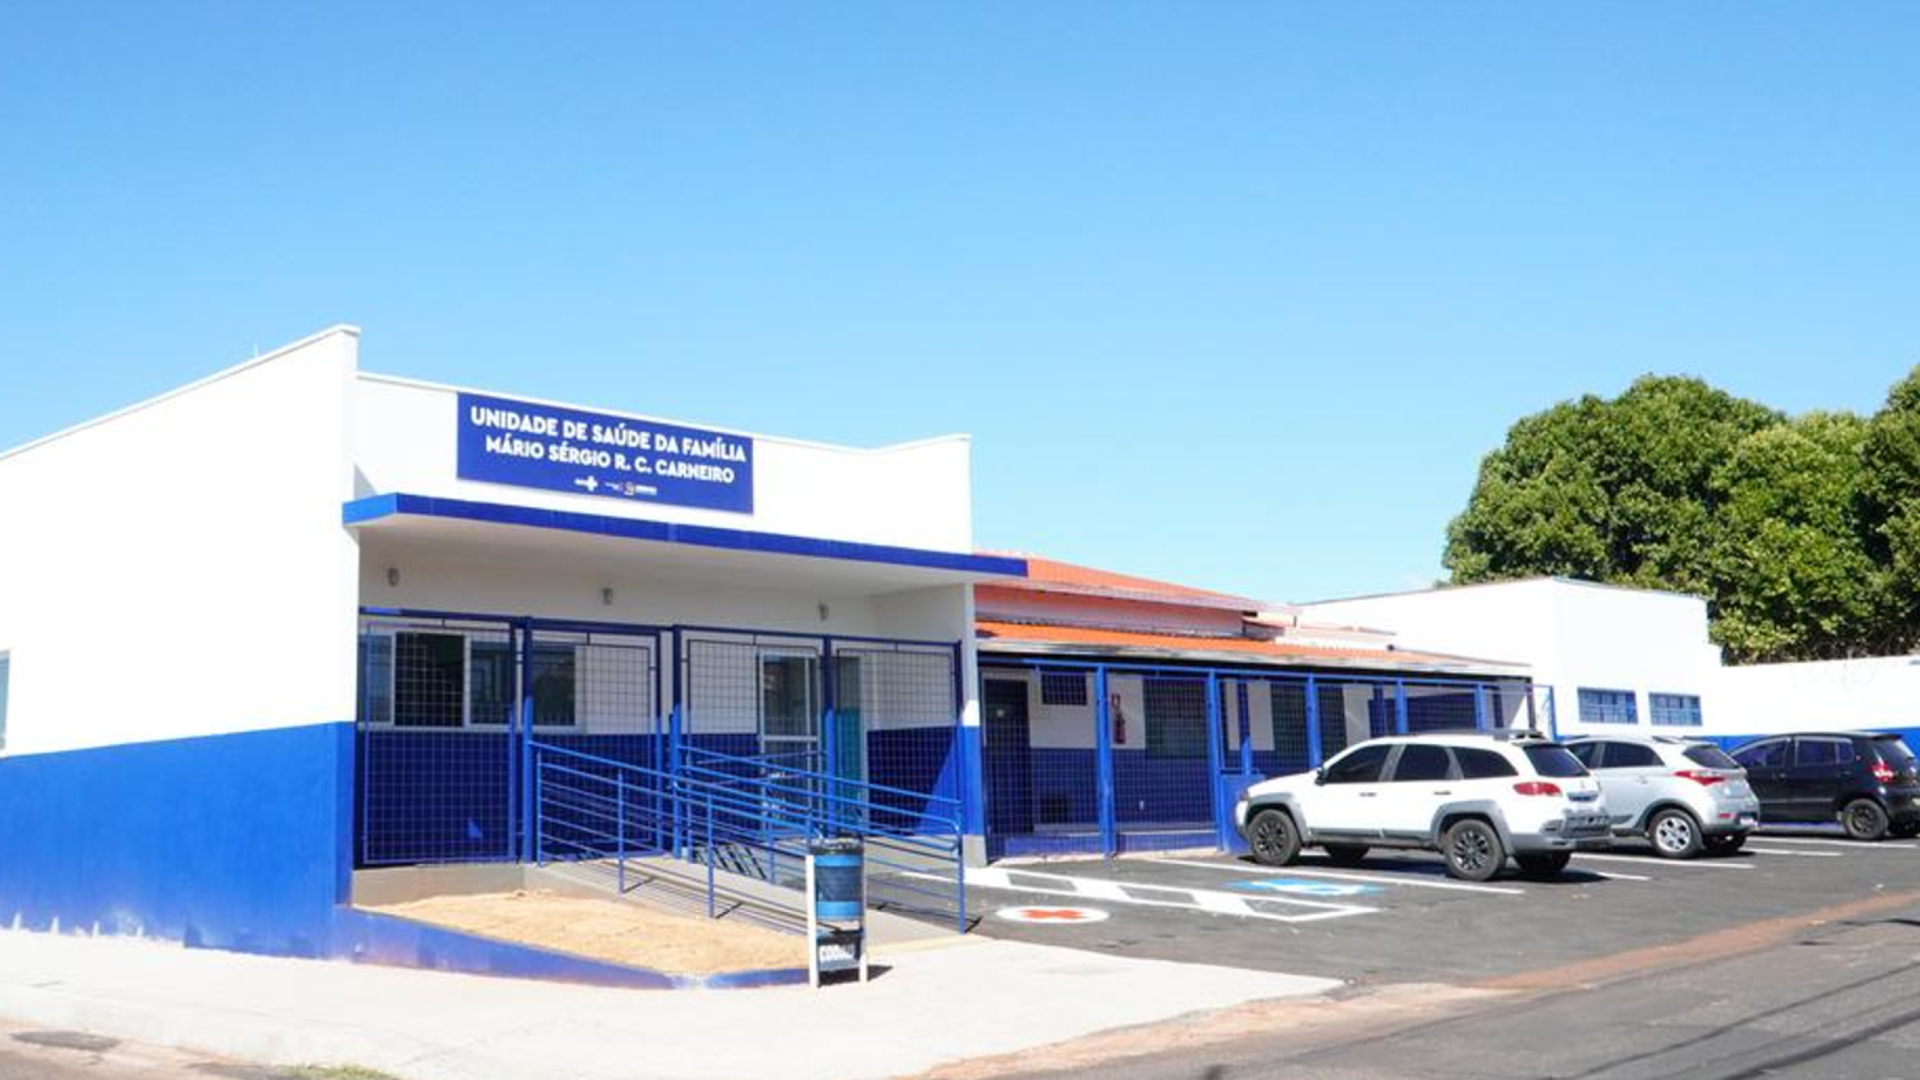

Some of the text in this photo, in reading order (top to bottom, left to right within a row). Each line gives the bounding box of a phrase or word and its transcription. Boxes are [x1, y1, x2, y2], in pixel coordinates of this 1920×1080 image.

[470, 405, 746, 462] UNIDADE DE SAÚDE DA FAMÍLIA
[485, 432, 735, 484] MÁRIO SÉRGIO R. C. CARNEIRO
